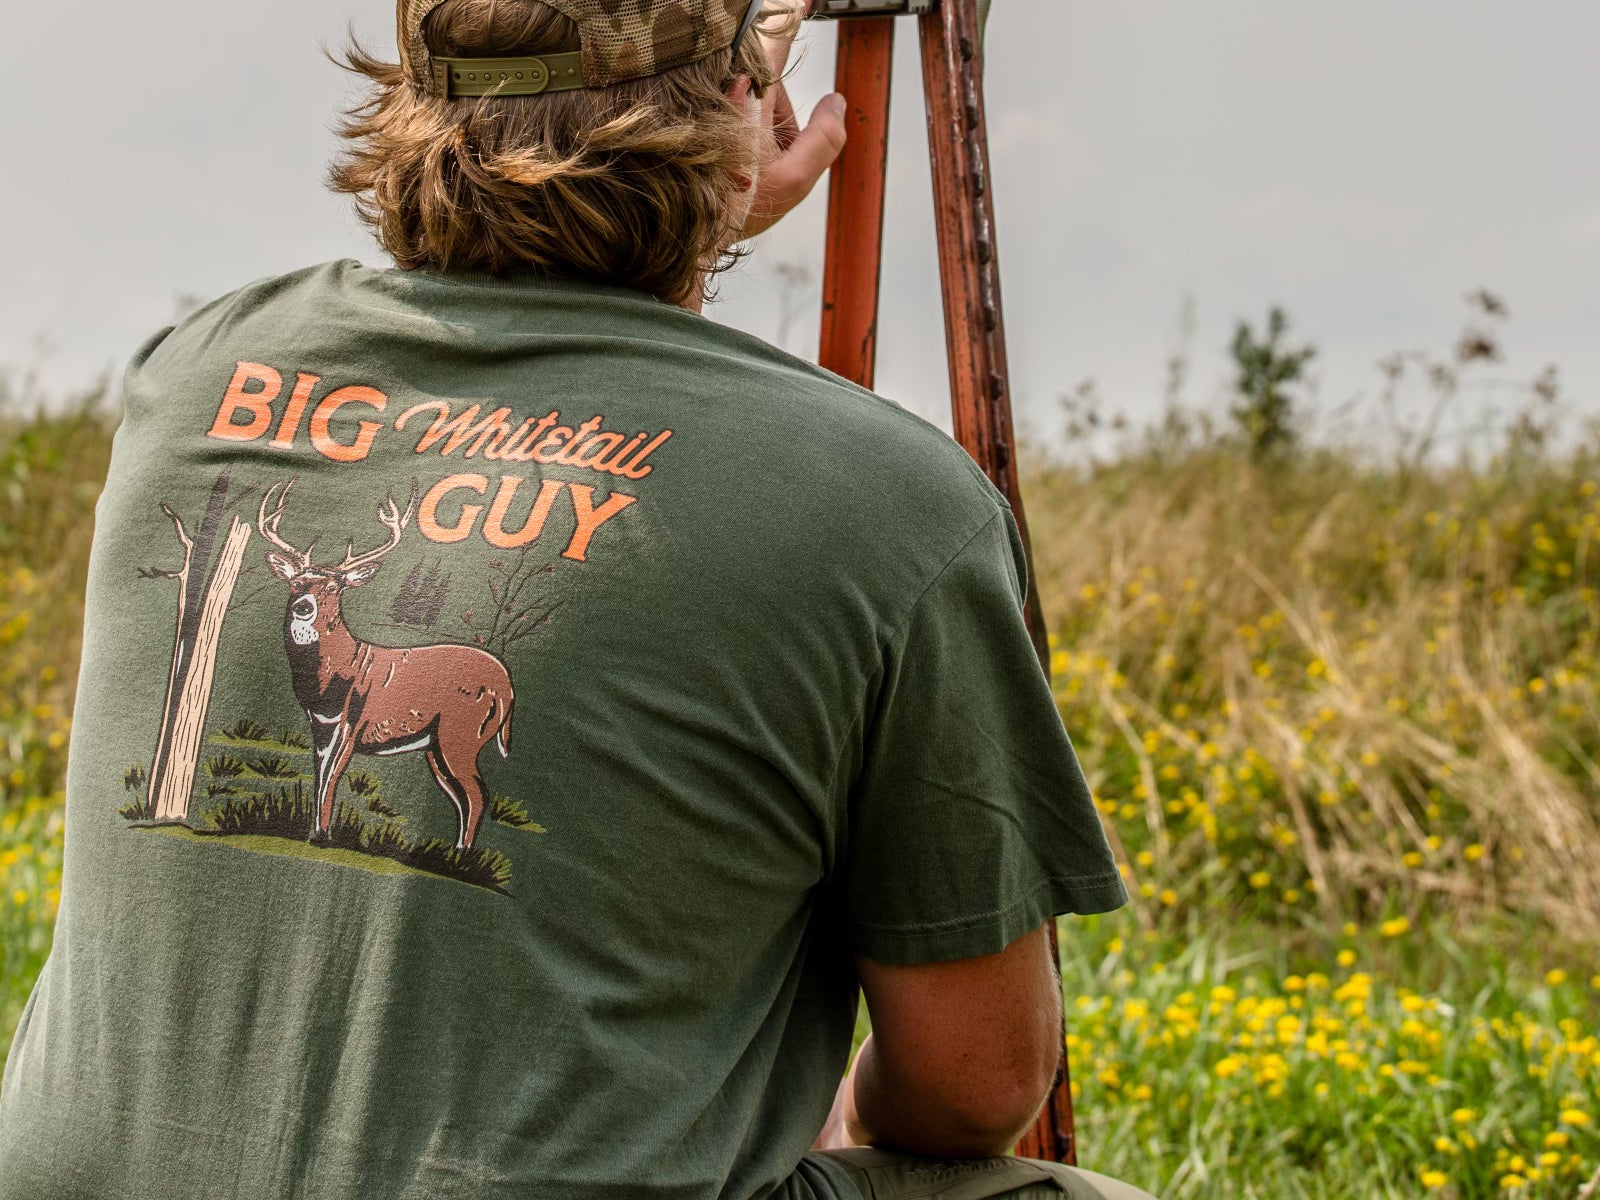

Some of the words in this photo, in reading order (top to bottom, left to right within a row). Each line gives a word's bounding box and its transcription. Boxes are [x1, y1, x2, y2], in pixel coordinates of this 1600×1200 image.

[205, 360, 388, 462] BIG
[394, 400, 673, 480] Whitetail
[417, 472, 637, 562] GUY
